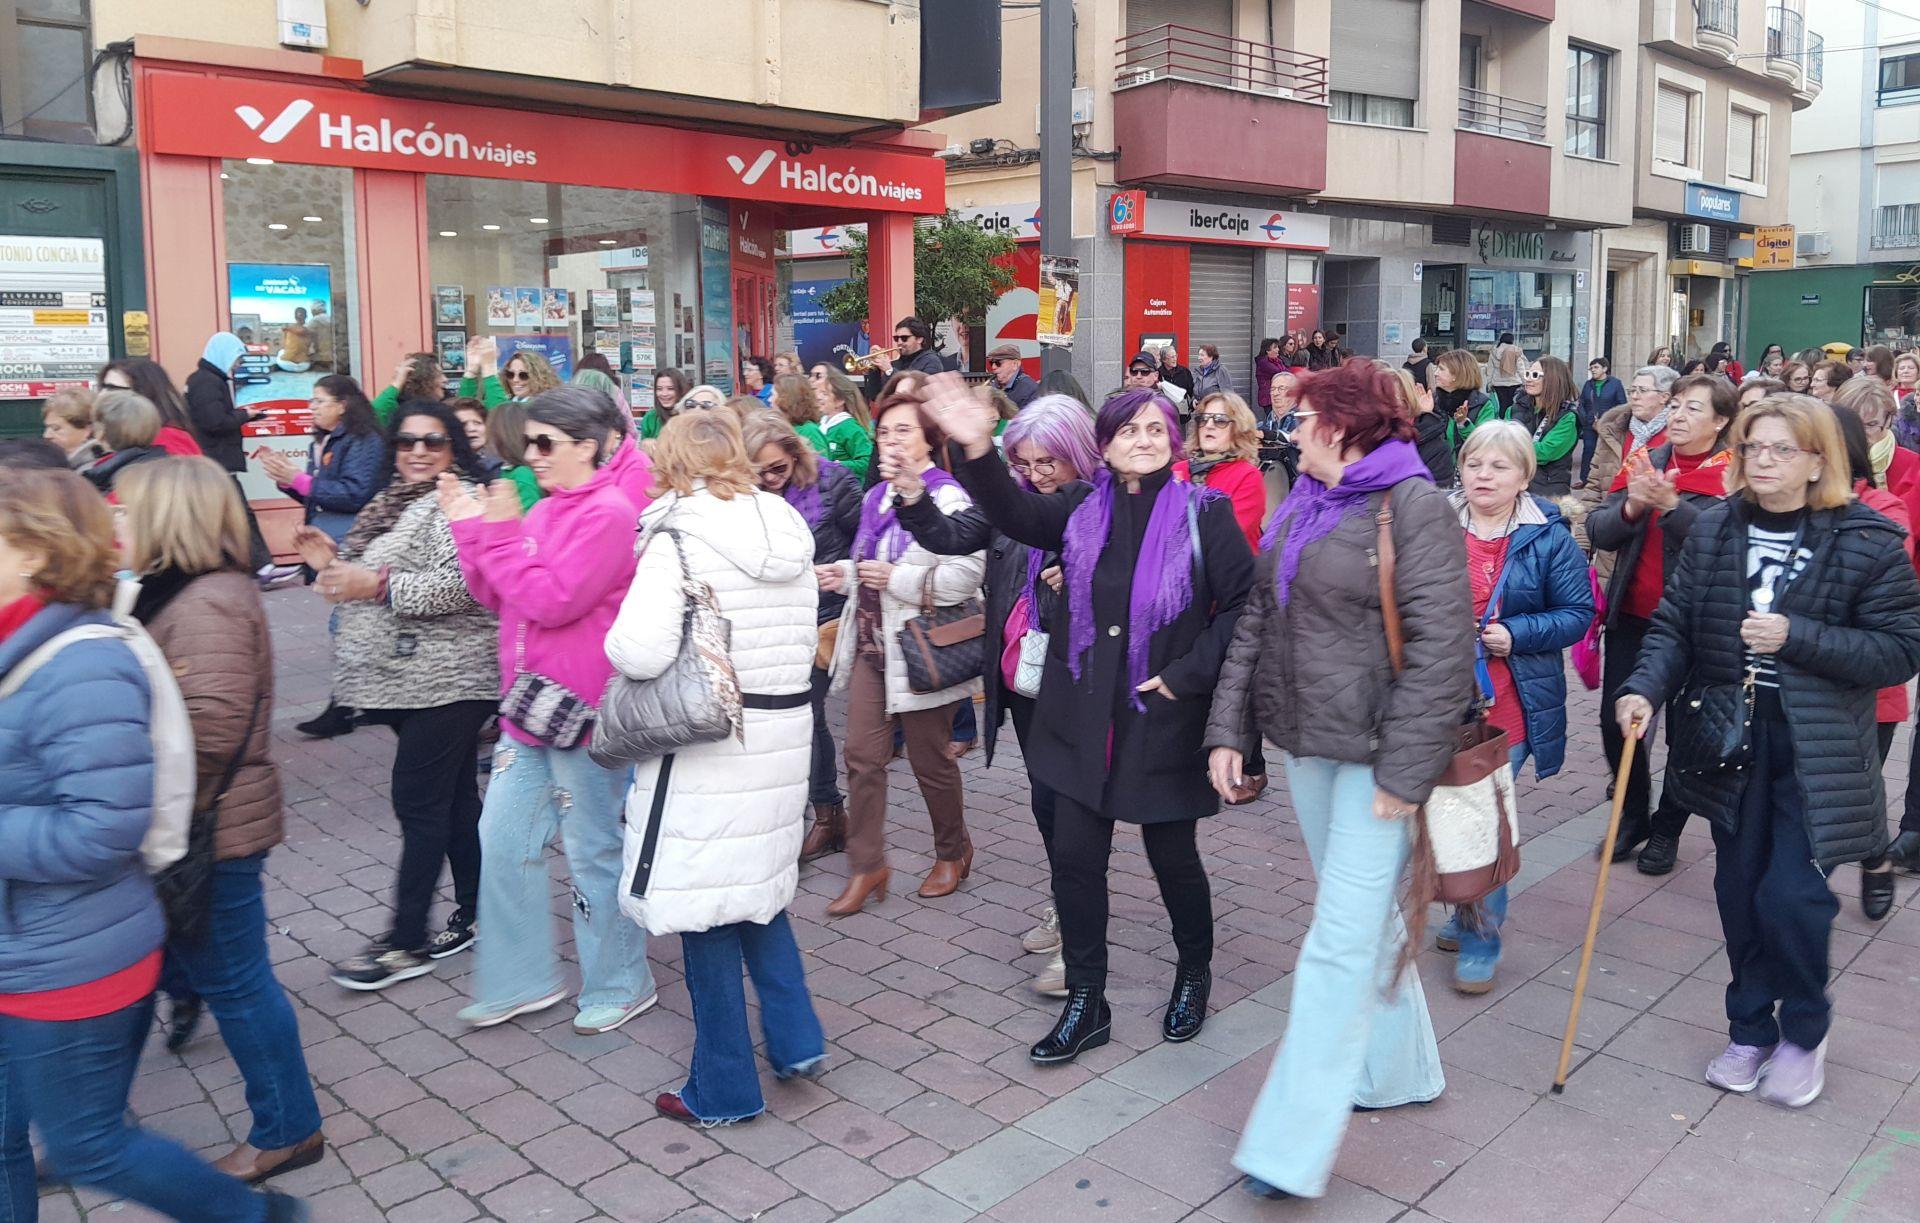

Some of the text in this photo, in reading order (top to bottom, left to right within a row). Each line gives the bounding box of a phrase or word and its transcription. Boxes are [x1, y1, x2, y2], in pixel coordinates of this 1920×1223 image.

[318, 112, 538, 168] Halcón viajes
[780, 160, 922, 202] Halcón viajes
[1190, 208, 1249, 236] iberCaja
[1492, 228, 1543, 260] DAMA
[35, 245, 80, 263] CONCHA
[1769, 251, 1777, 265] 1
[1, 292, 62, 300] ALVARADO
[1149, 298, 1167, 307] Cajero
[1143, 308, 1173, 316] Automático
